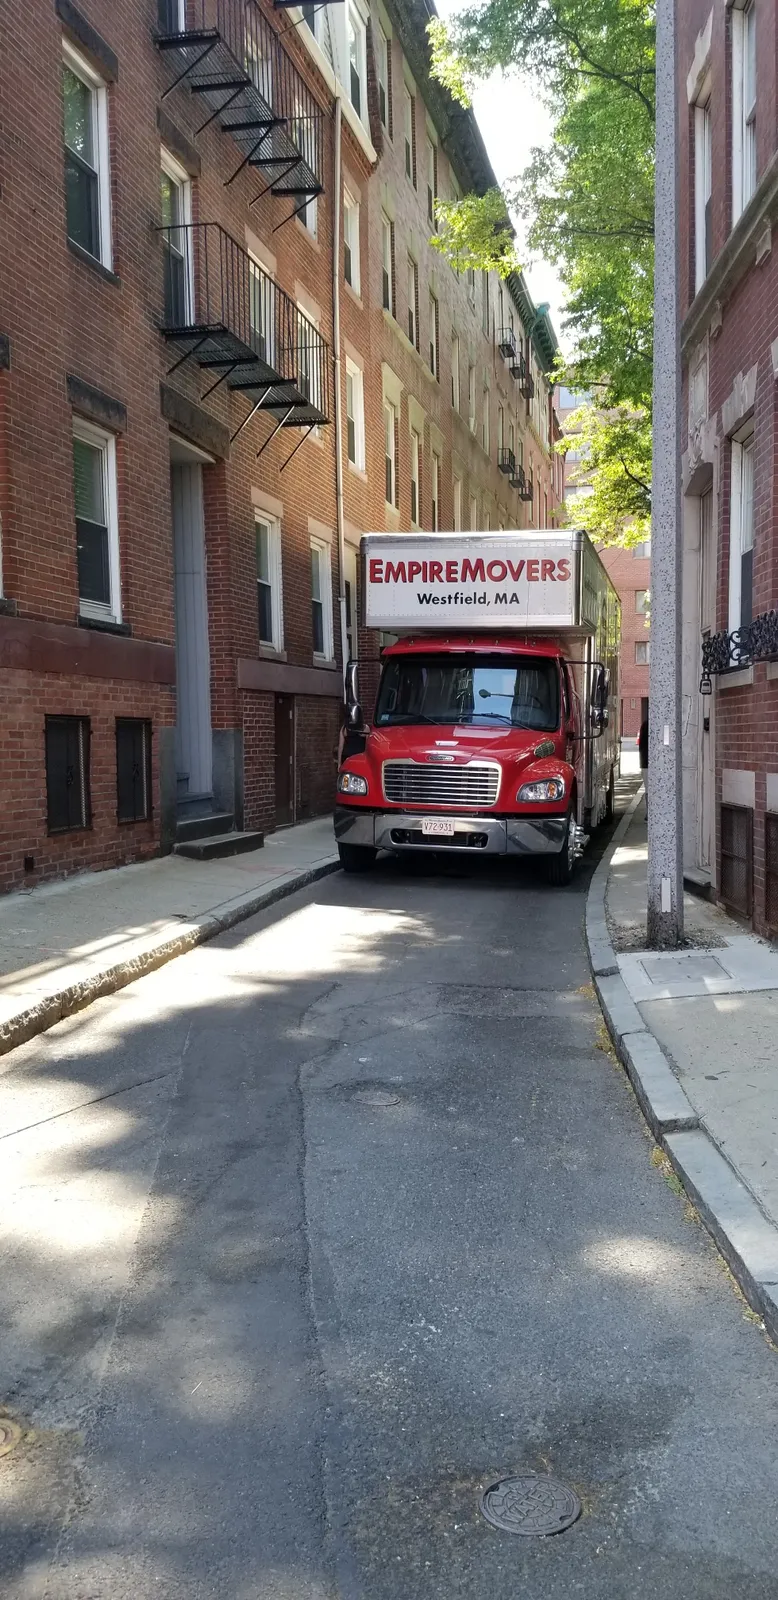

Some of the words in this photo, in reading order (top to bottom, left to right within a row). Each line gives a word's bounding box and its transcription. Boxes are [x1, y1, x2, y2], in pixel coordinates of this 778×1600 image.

[417, 592, 491, 606] Westfield,
[494, 593, 520, 604] MA
[501, 1481, 557, 1523] WATER
